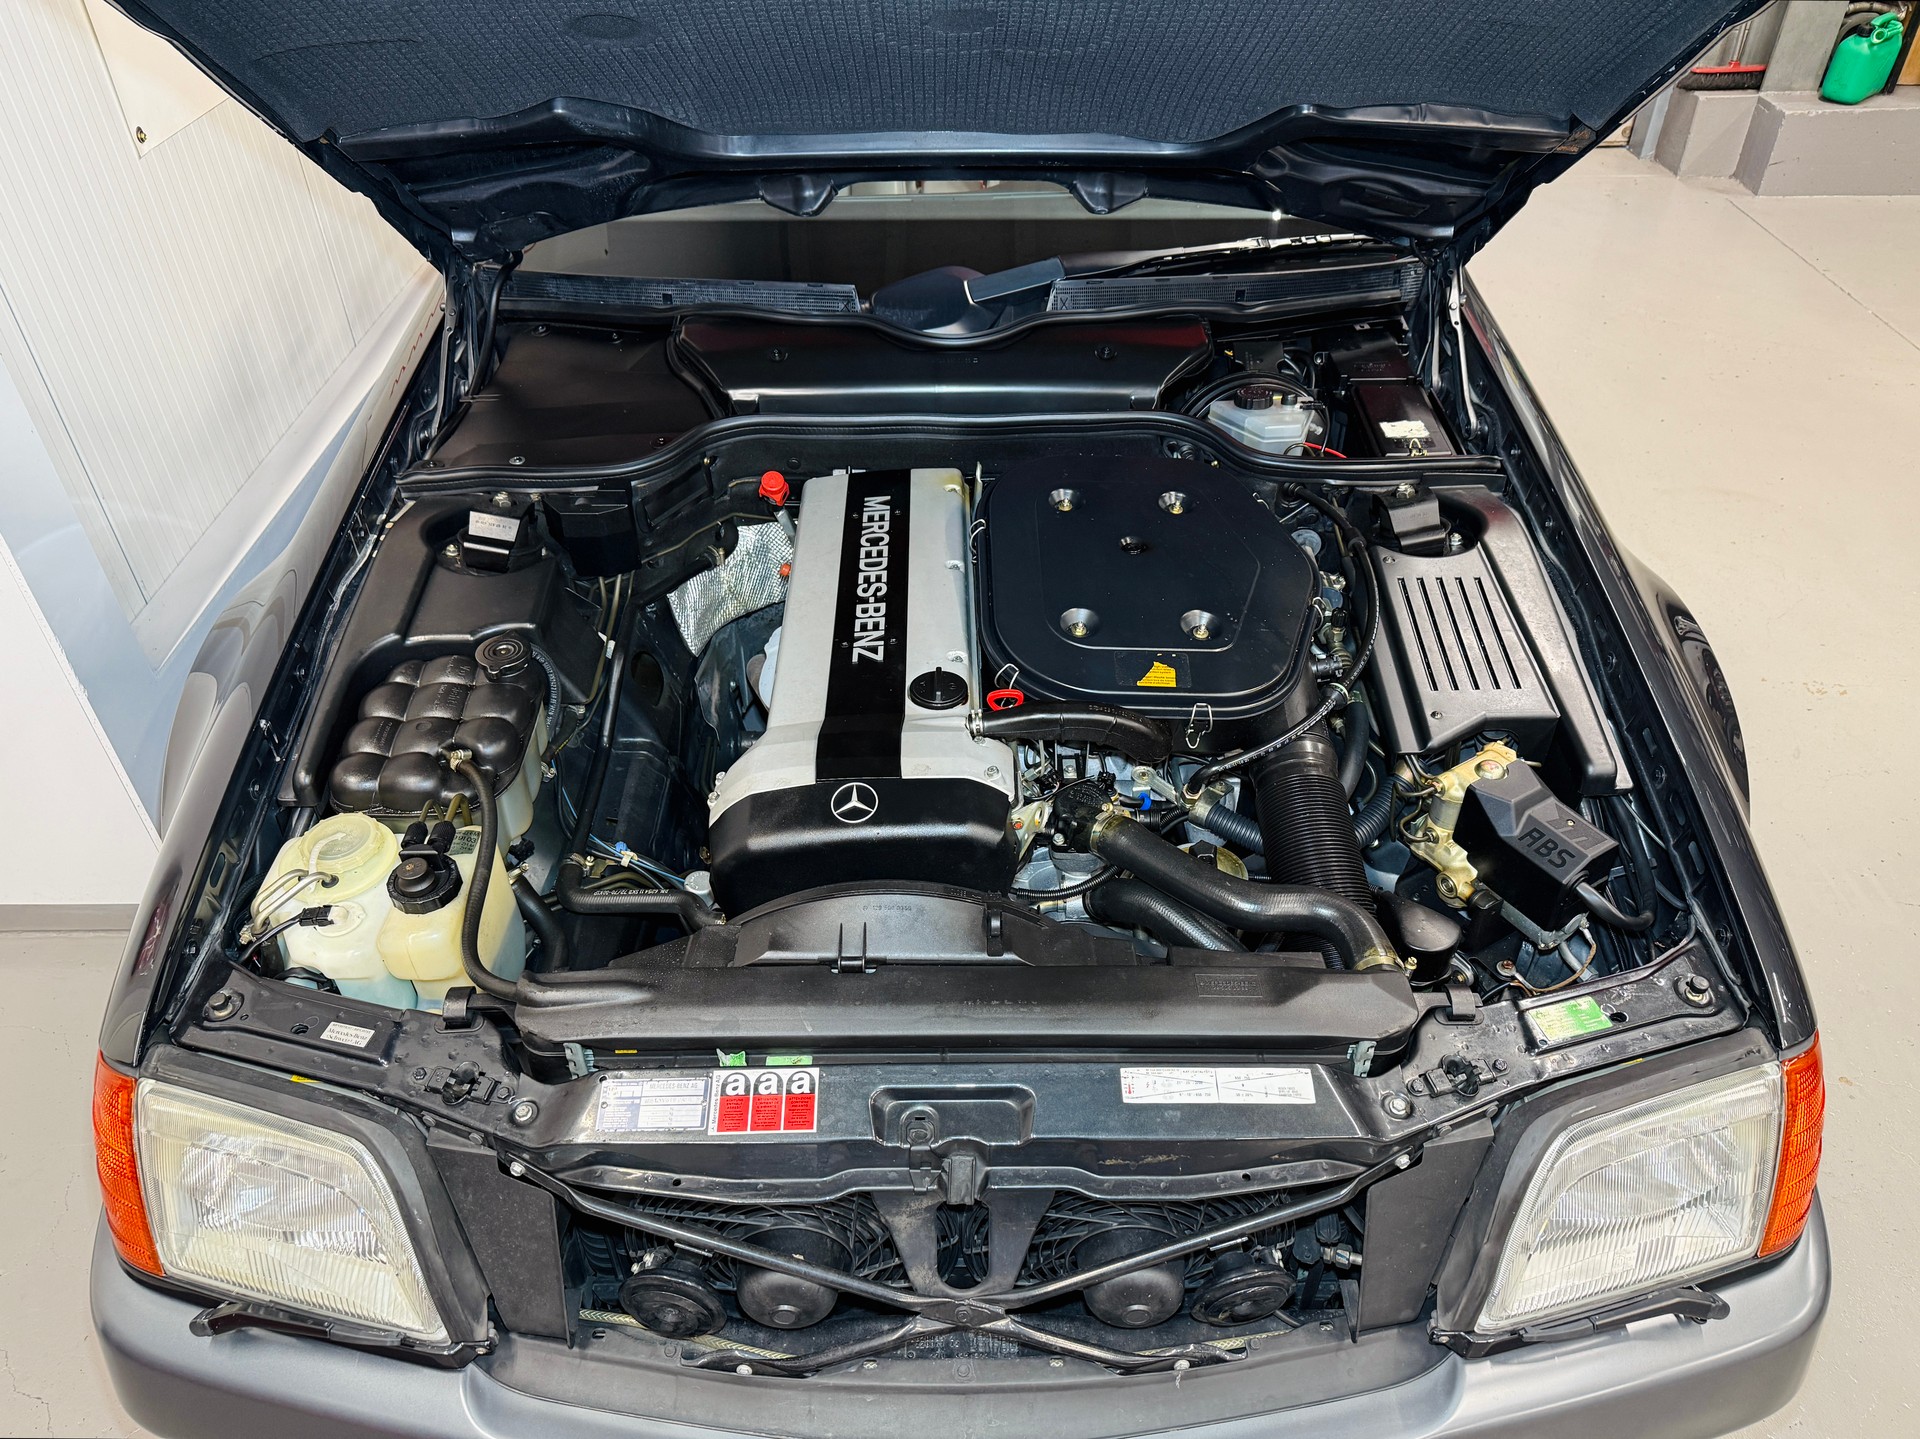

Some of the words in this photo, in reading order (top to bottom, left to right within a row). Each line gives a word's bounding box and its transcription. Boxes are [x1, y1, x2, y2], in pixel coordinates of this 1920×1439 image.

[851, 495, 891, 664] MERCEDES-BENZ
[1518, 827, 1576, 869] ABS
[725, 1073, 746, 1096] a
[758, 1073, 778, 1095] a
[790, 1072, 811, 1094] a
